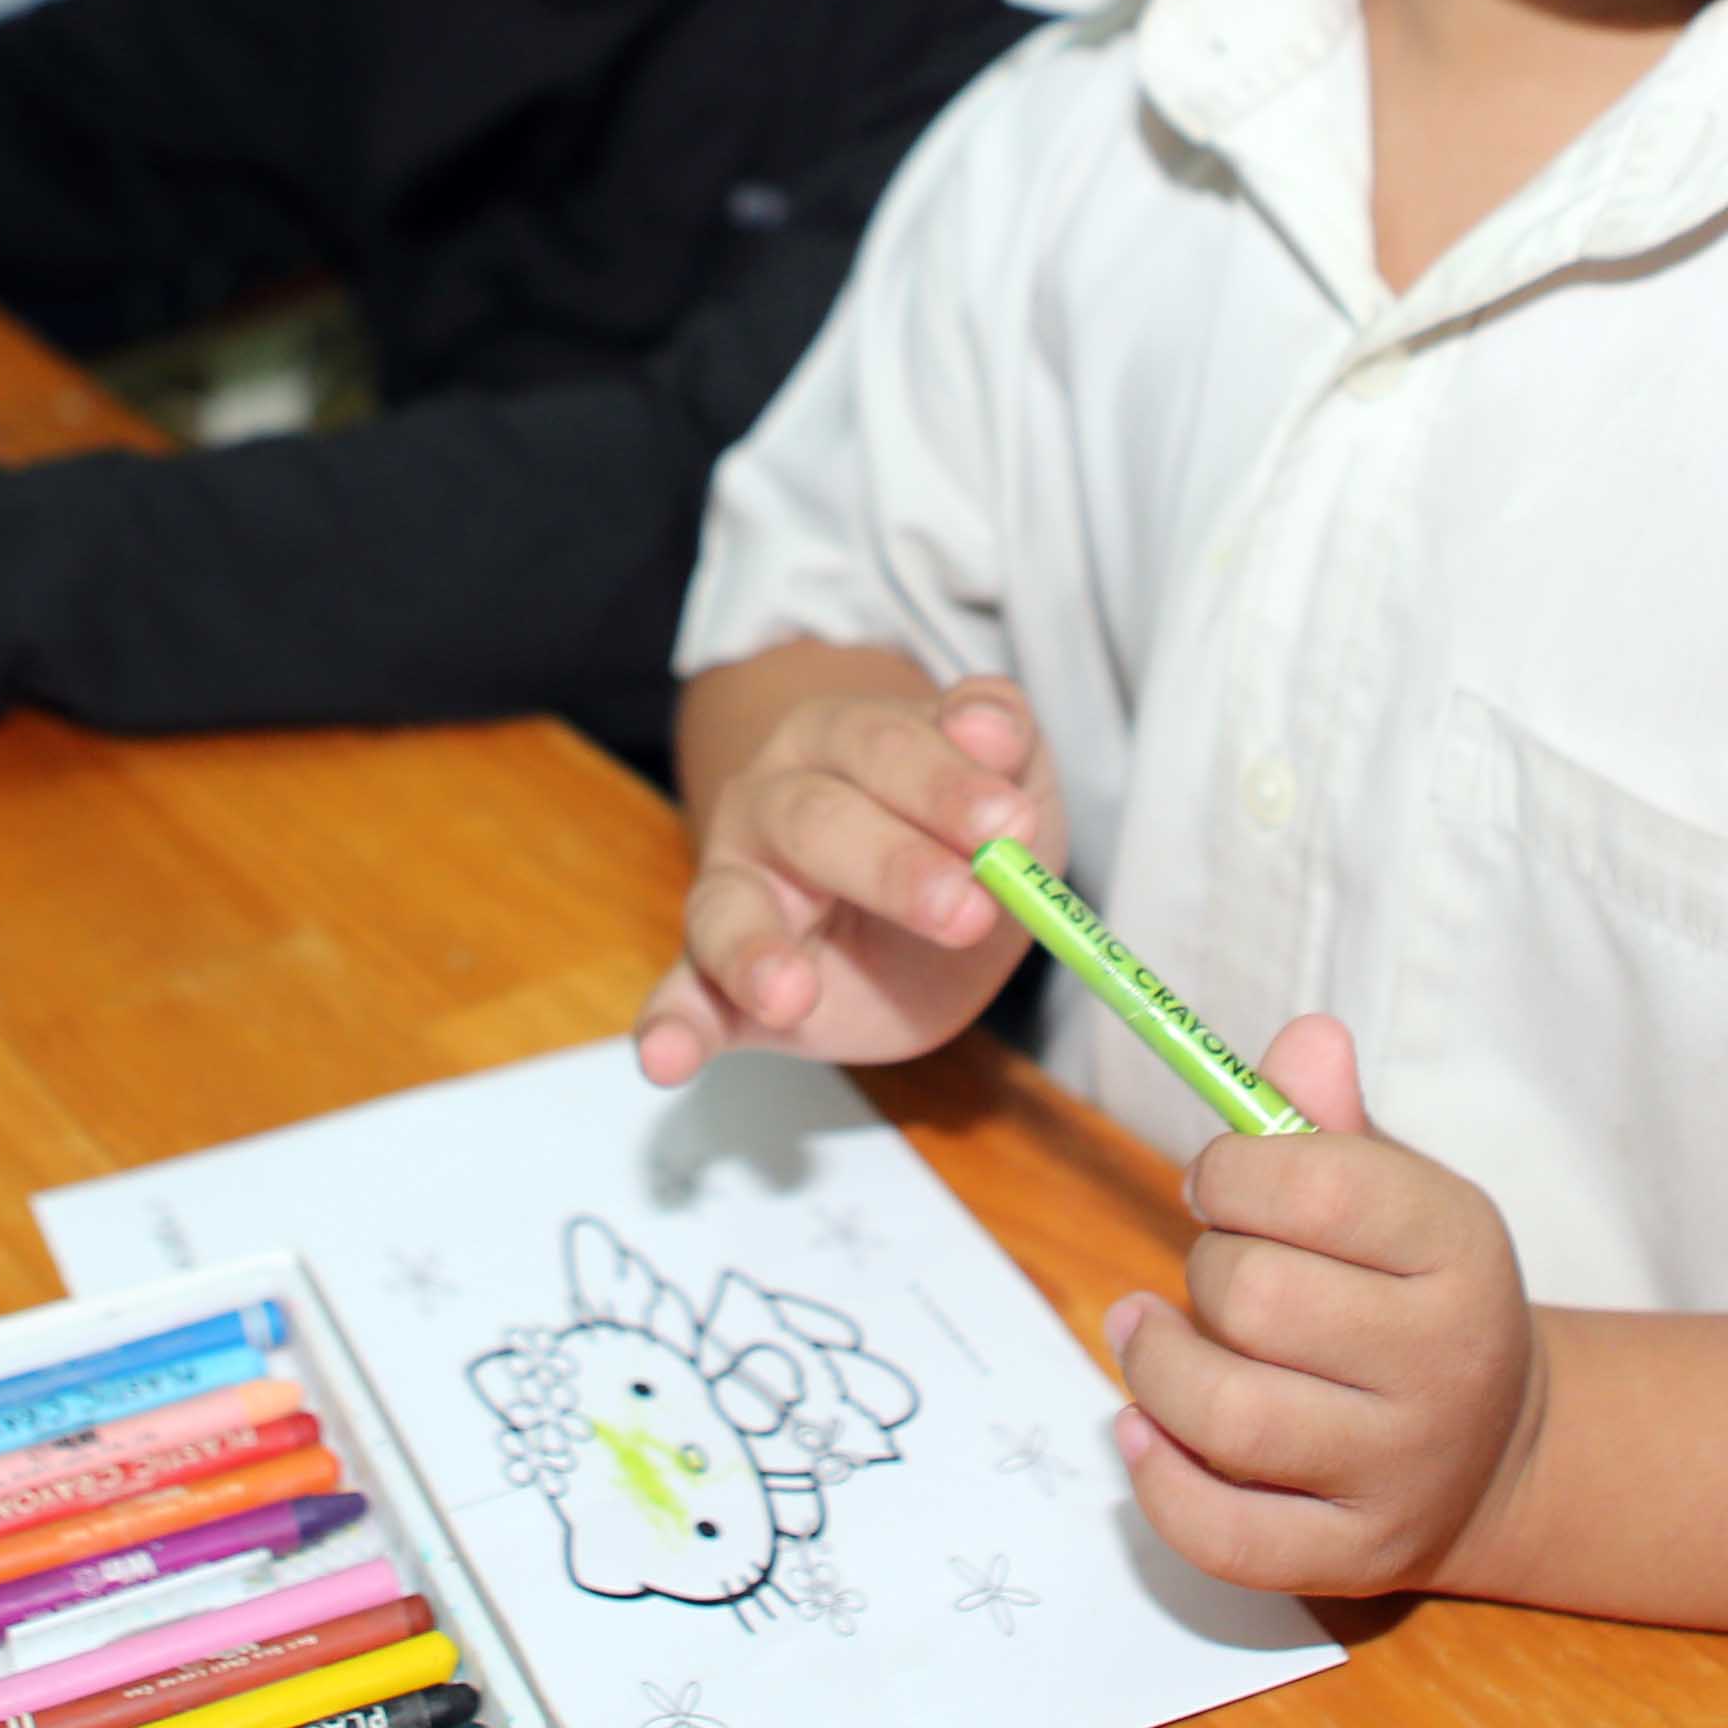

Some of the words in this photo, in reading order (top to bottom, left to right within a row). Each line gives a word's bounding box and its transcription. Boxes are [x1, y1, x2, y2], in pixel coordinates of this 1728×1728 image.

[1023, 861, 1127, 963] PLASTIC
[1134, 966, 1260, 1091] CRAYONS
[129, 1426, 258, 1482] PLASTIC
